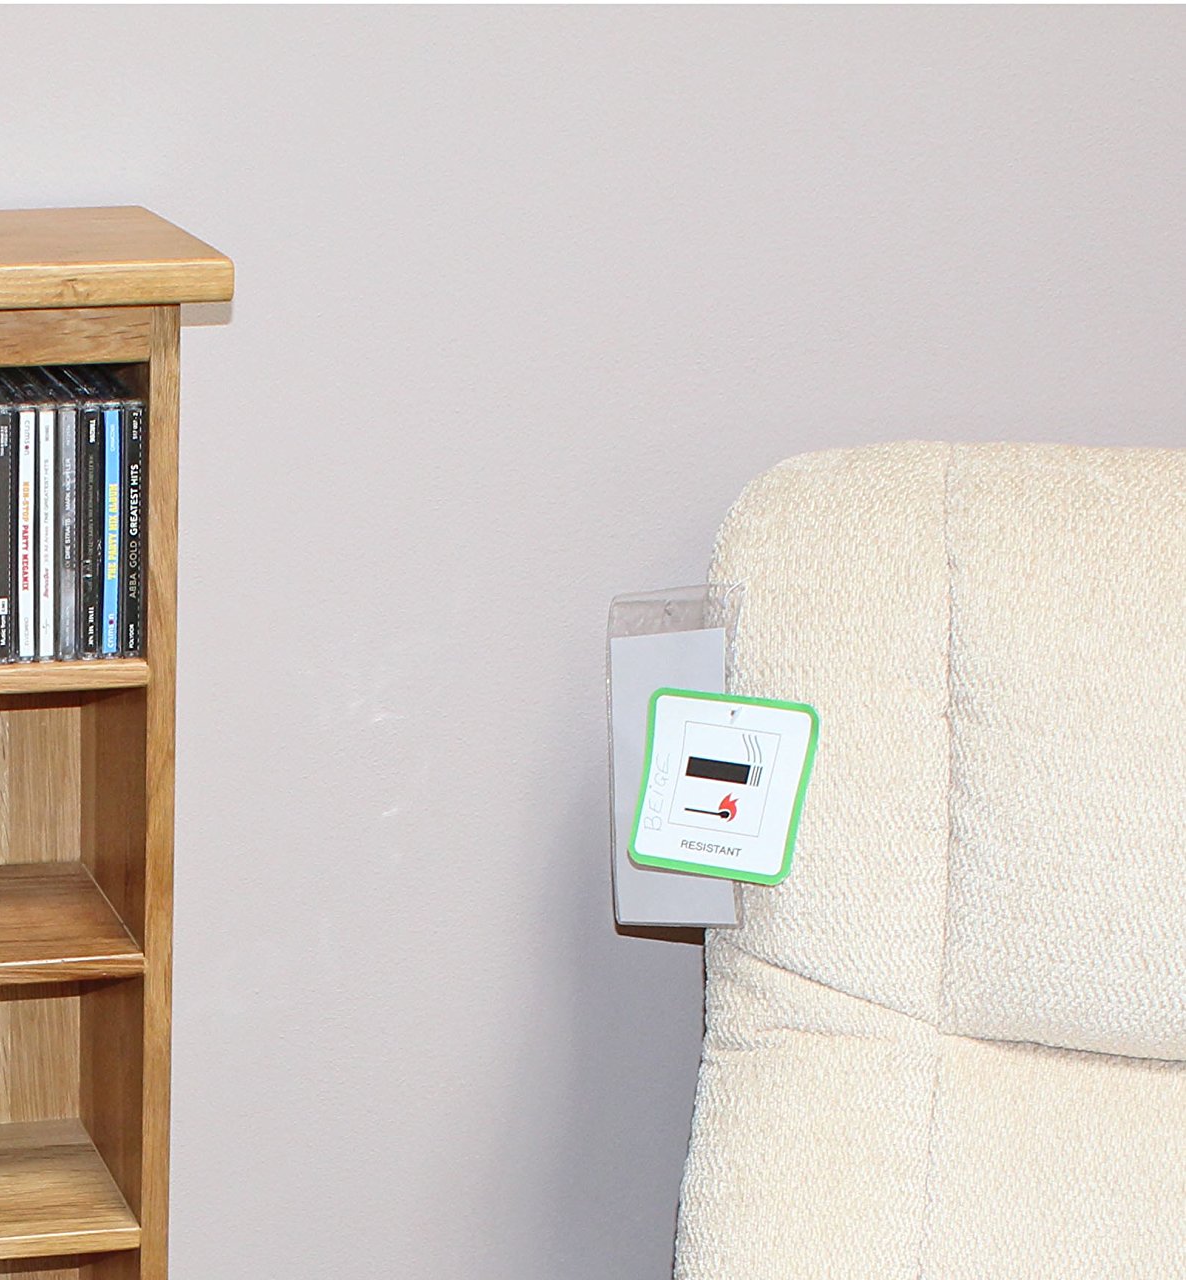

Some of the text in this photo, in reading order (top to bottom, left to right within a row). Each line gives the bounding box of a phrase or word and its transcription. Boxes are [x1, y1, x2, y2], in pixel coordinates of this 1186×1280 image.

[64, 458, 72, 491] KNOPFLER
[21, 481, 30, 592] NON-STOP PARTY MEGAMIX
[108, 483, 118, 580] THE PARTY MIX ALBUM
[129, 464, 139, 598] ABBA GOLD GREATEST HITS
[680, 839, 742, 858] RESISTANT
